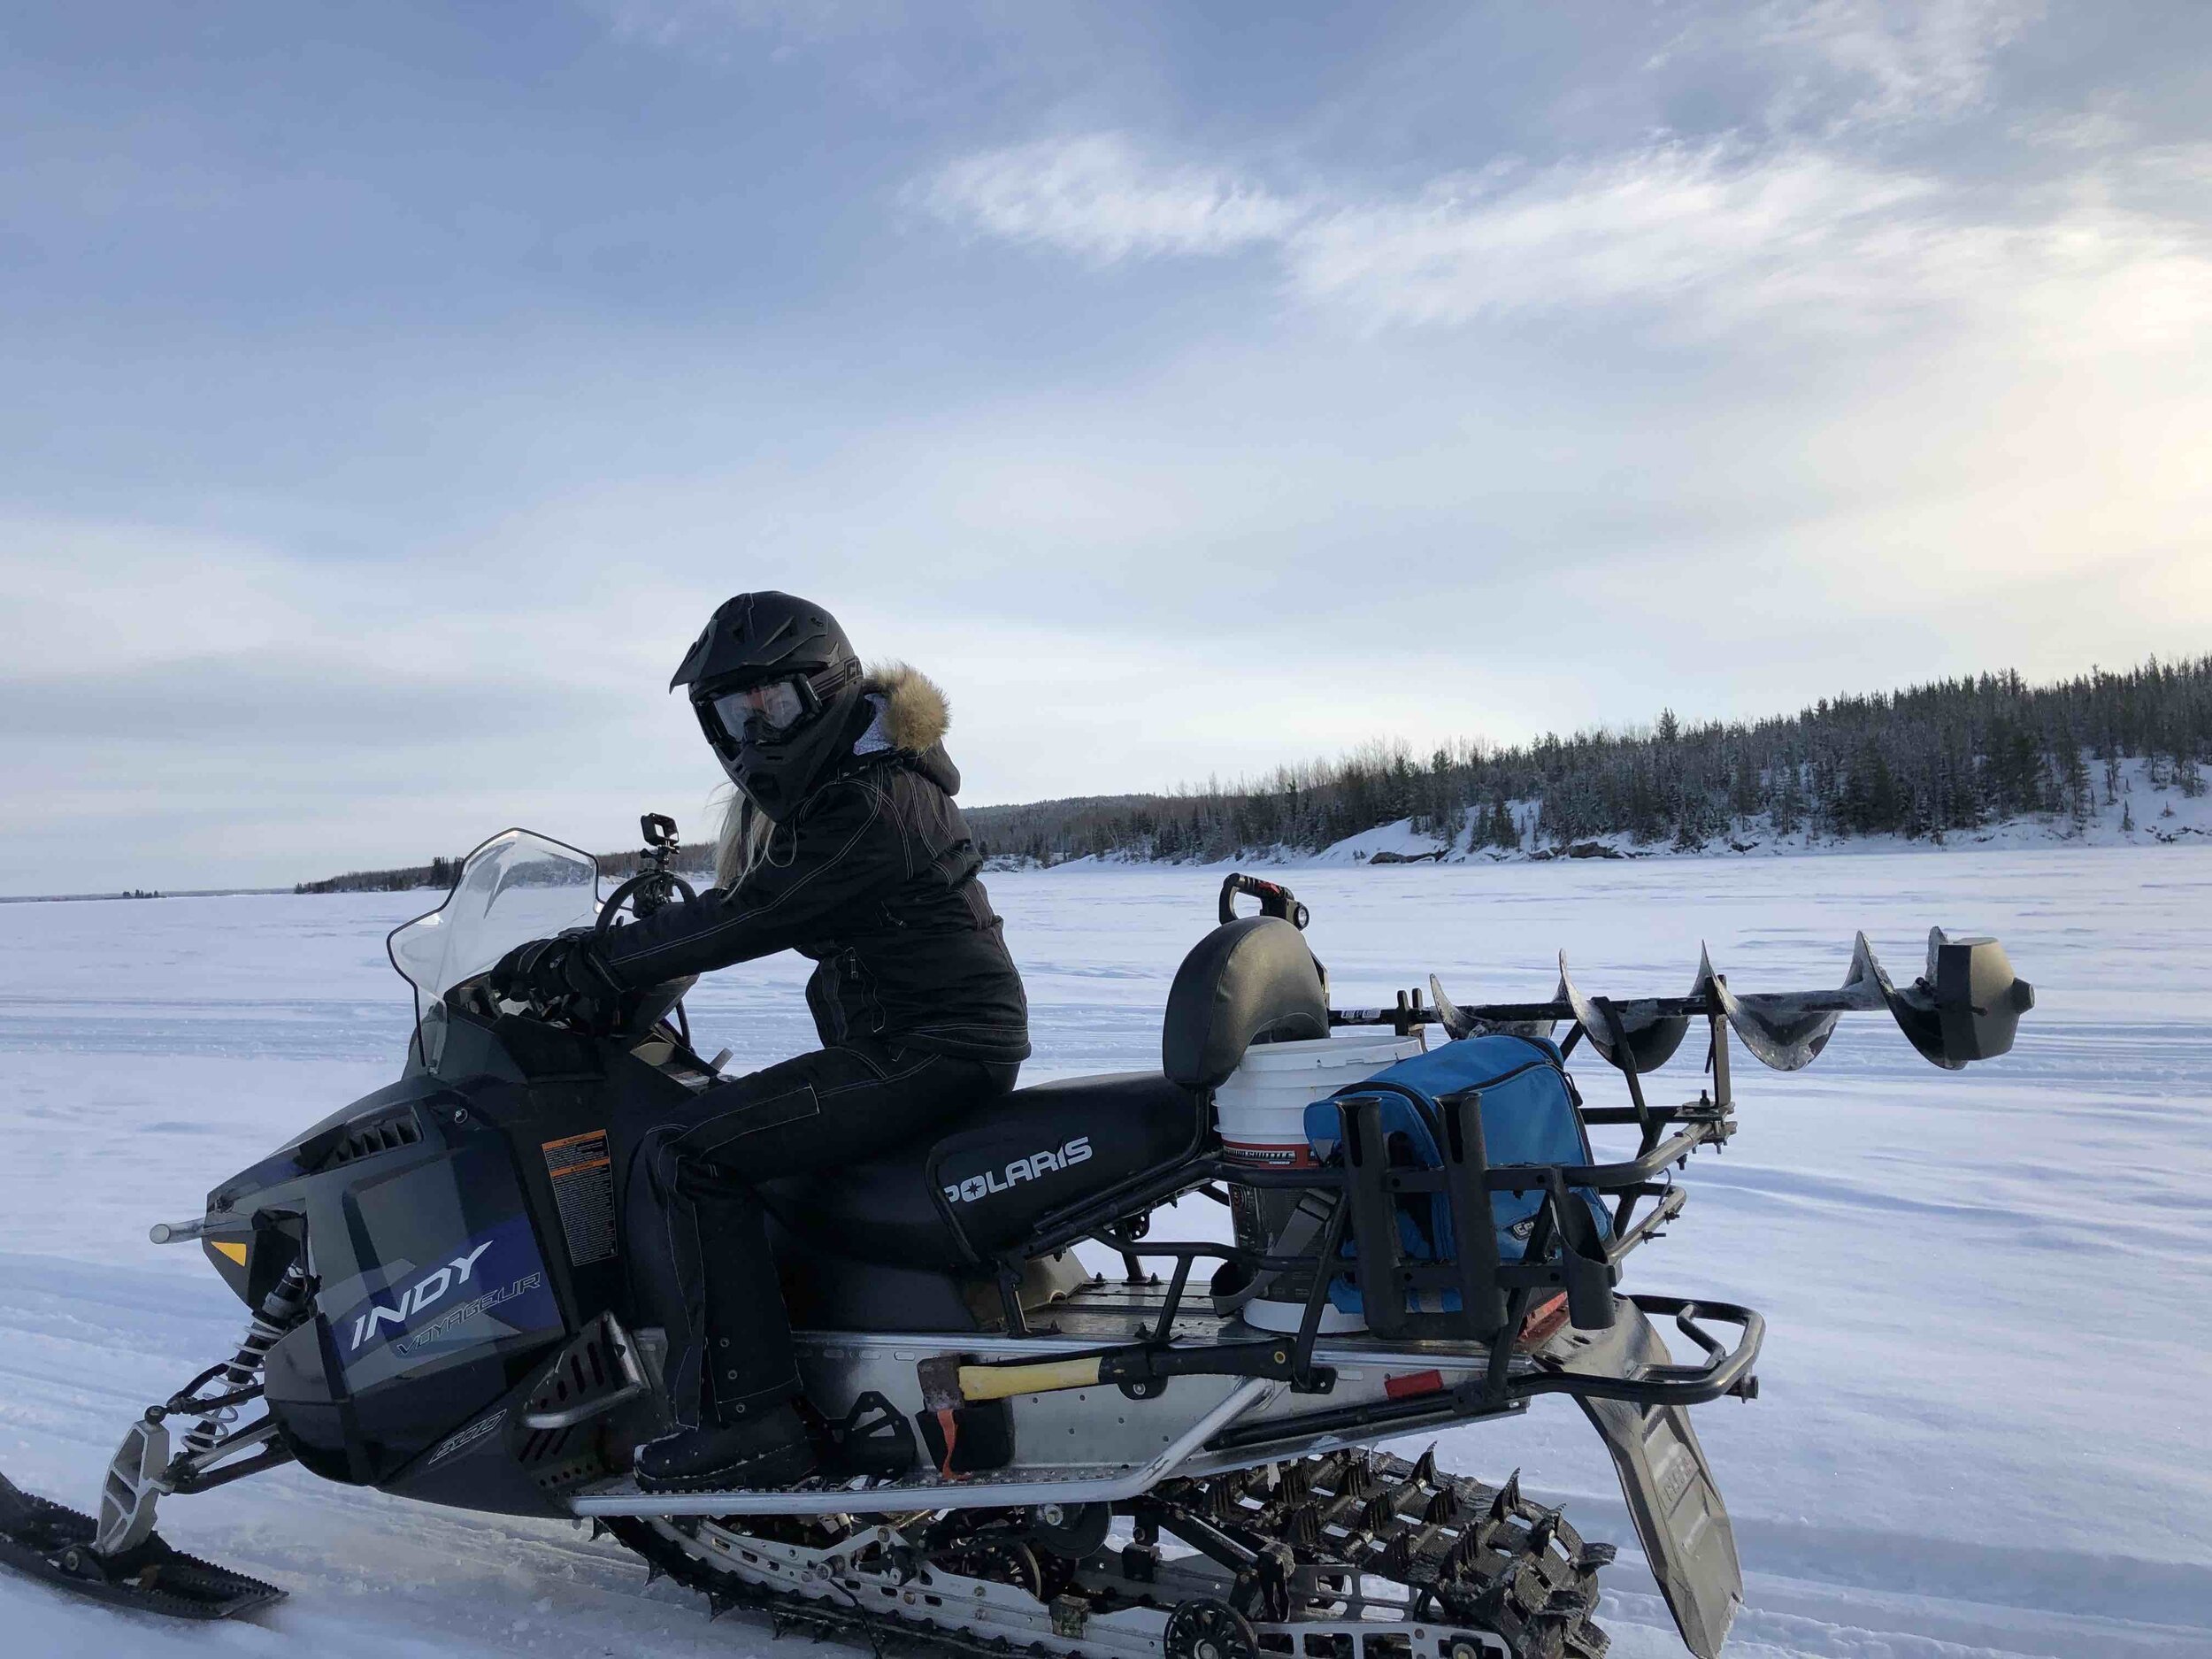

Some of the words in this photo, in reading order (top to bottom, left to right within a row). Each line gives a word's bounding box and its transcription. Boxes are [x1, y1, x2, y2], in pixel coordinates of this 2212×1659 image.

[944, 1137, 1094, 1203] POLARIS
[351, 1241, 493, 1349] INDY
[396, 1271, 541, 1355] VOYAGEUR
